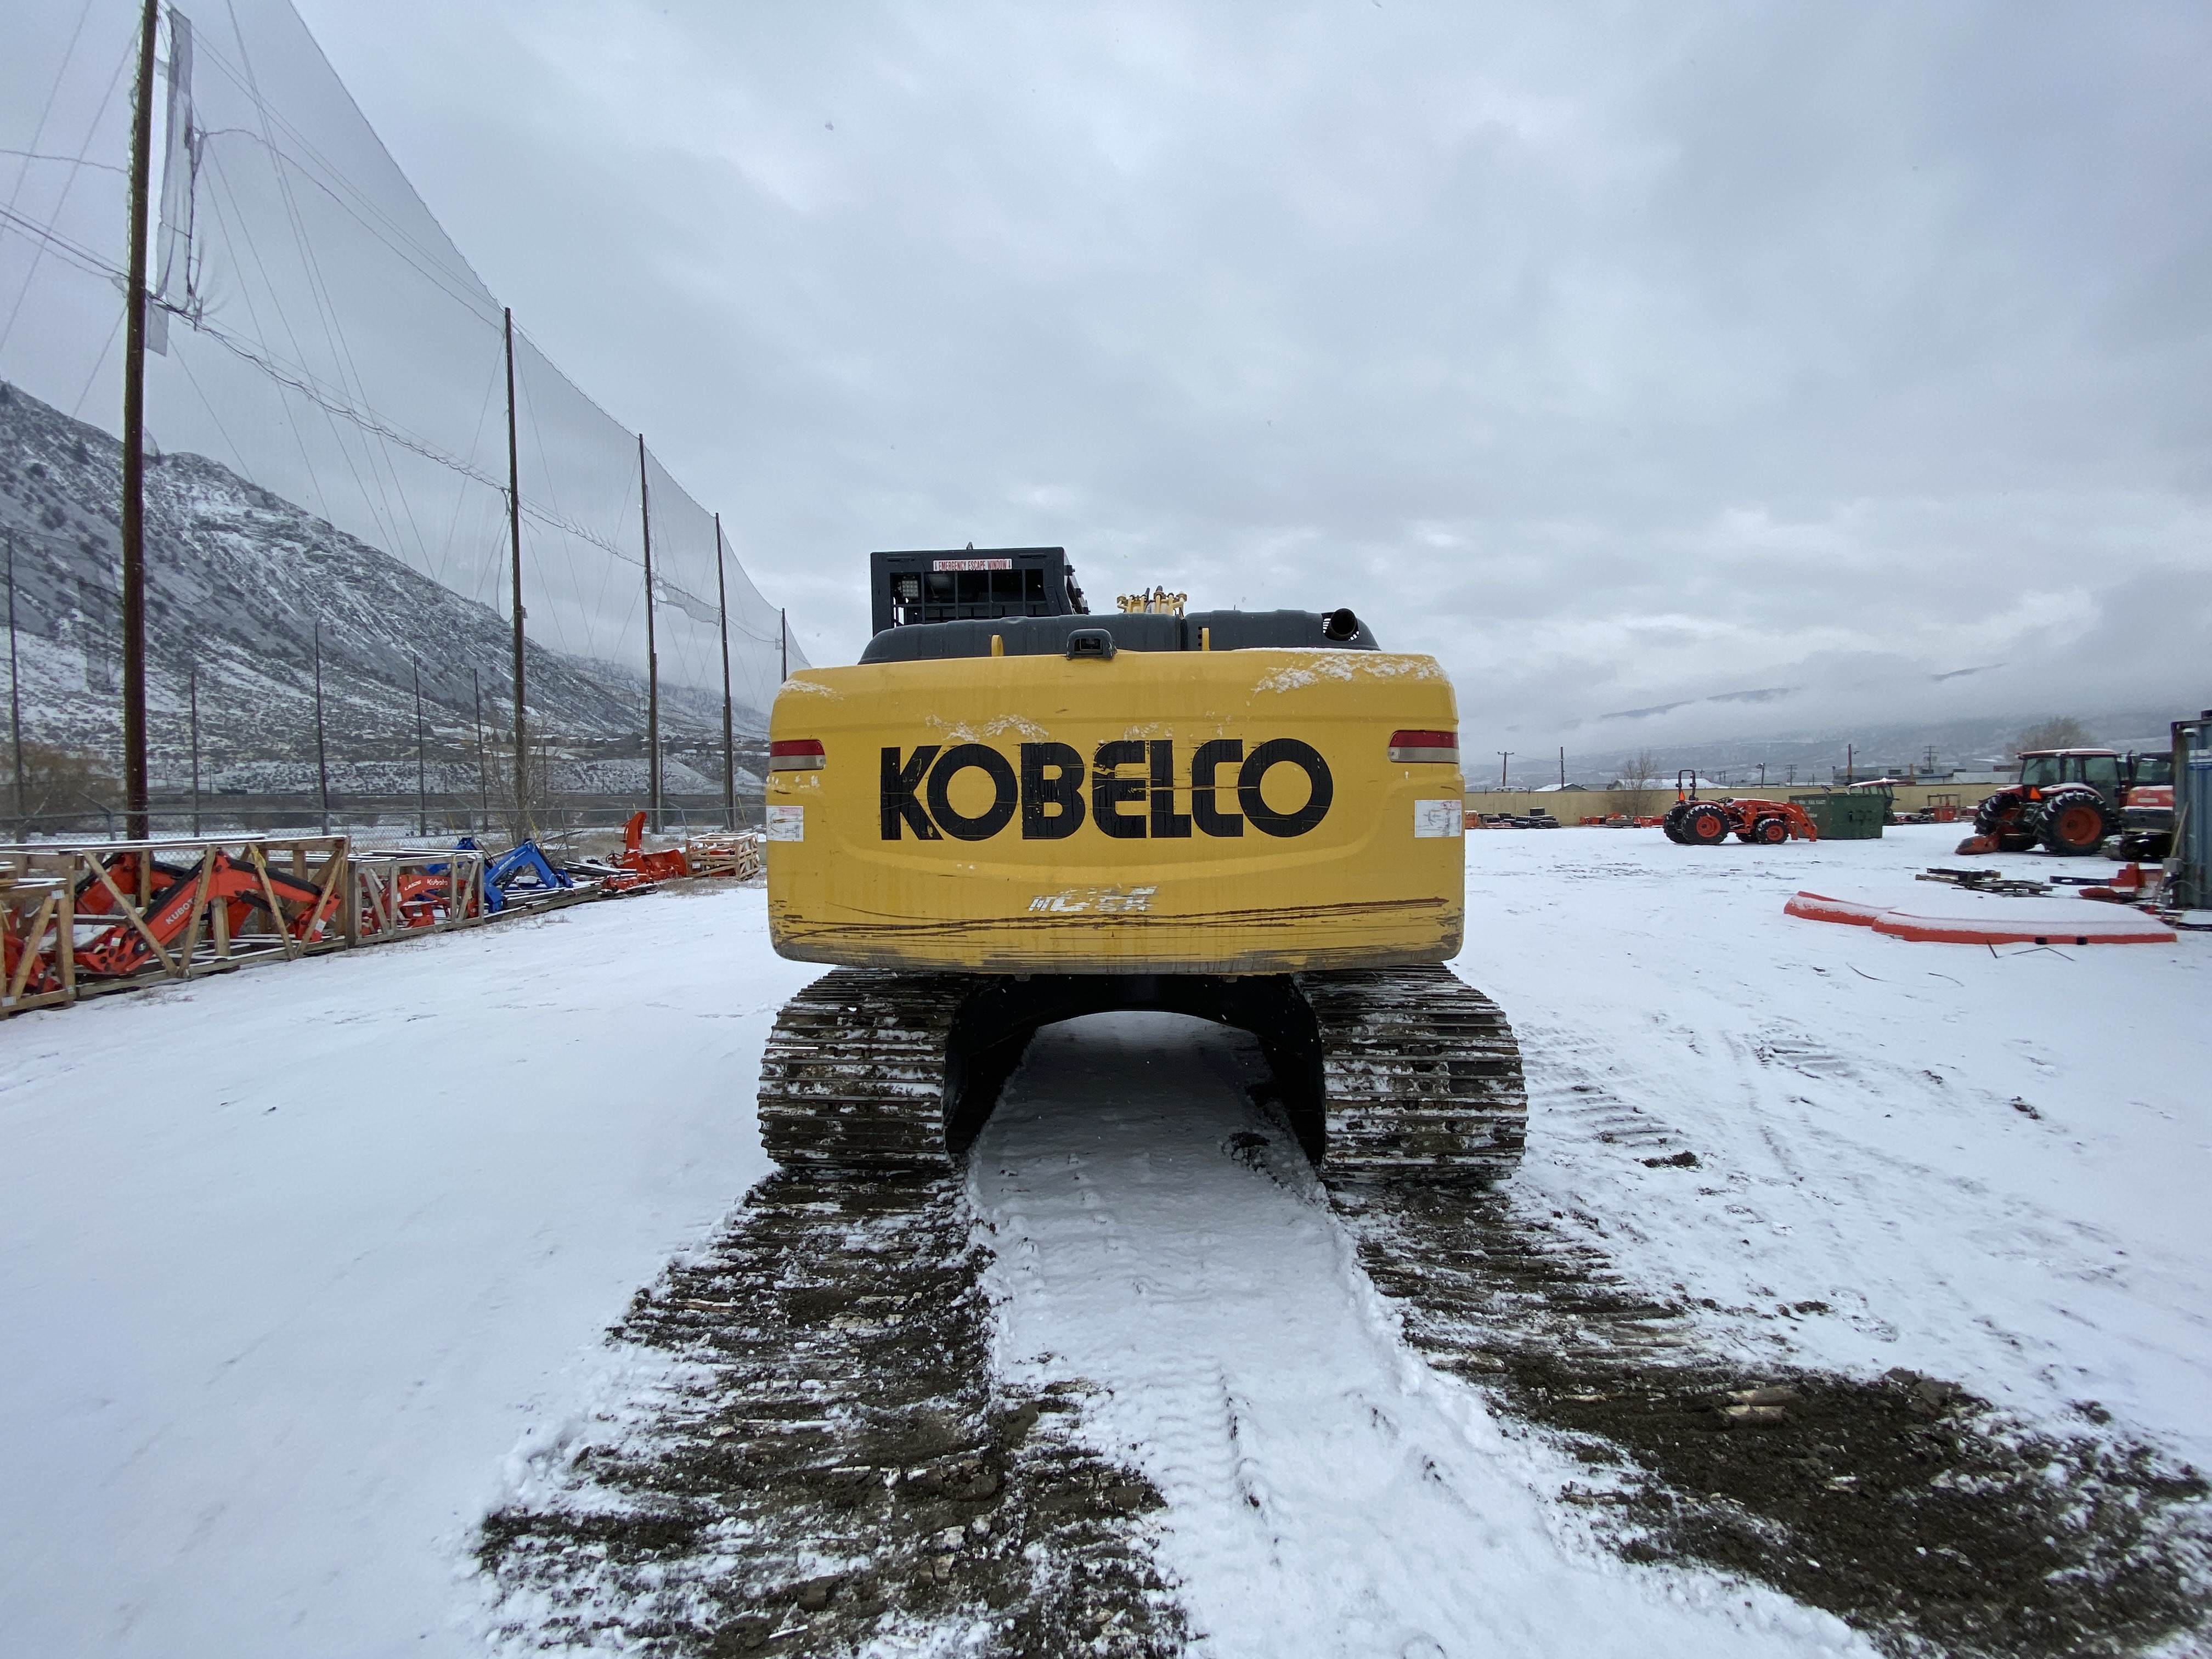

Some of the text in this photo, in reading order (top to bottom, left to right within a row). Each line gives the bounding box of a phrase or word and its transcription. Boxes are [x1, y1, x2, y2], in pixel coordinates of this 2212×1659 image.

[939, 561, 966, 571] EMERGENCY
[968, 561, 985, 570] ESCAPE
[988, 560, 1006, 570] WINDOW
[881, 738, 1333, 840] KOBELCO
[166, 898, 193, 924] KUBOT
